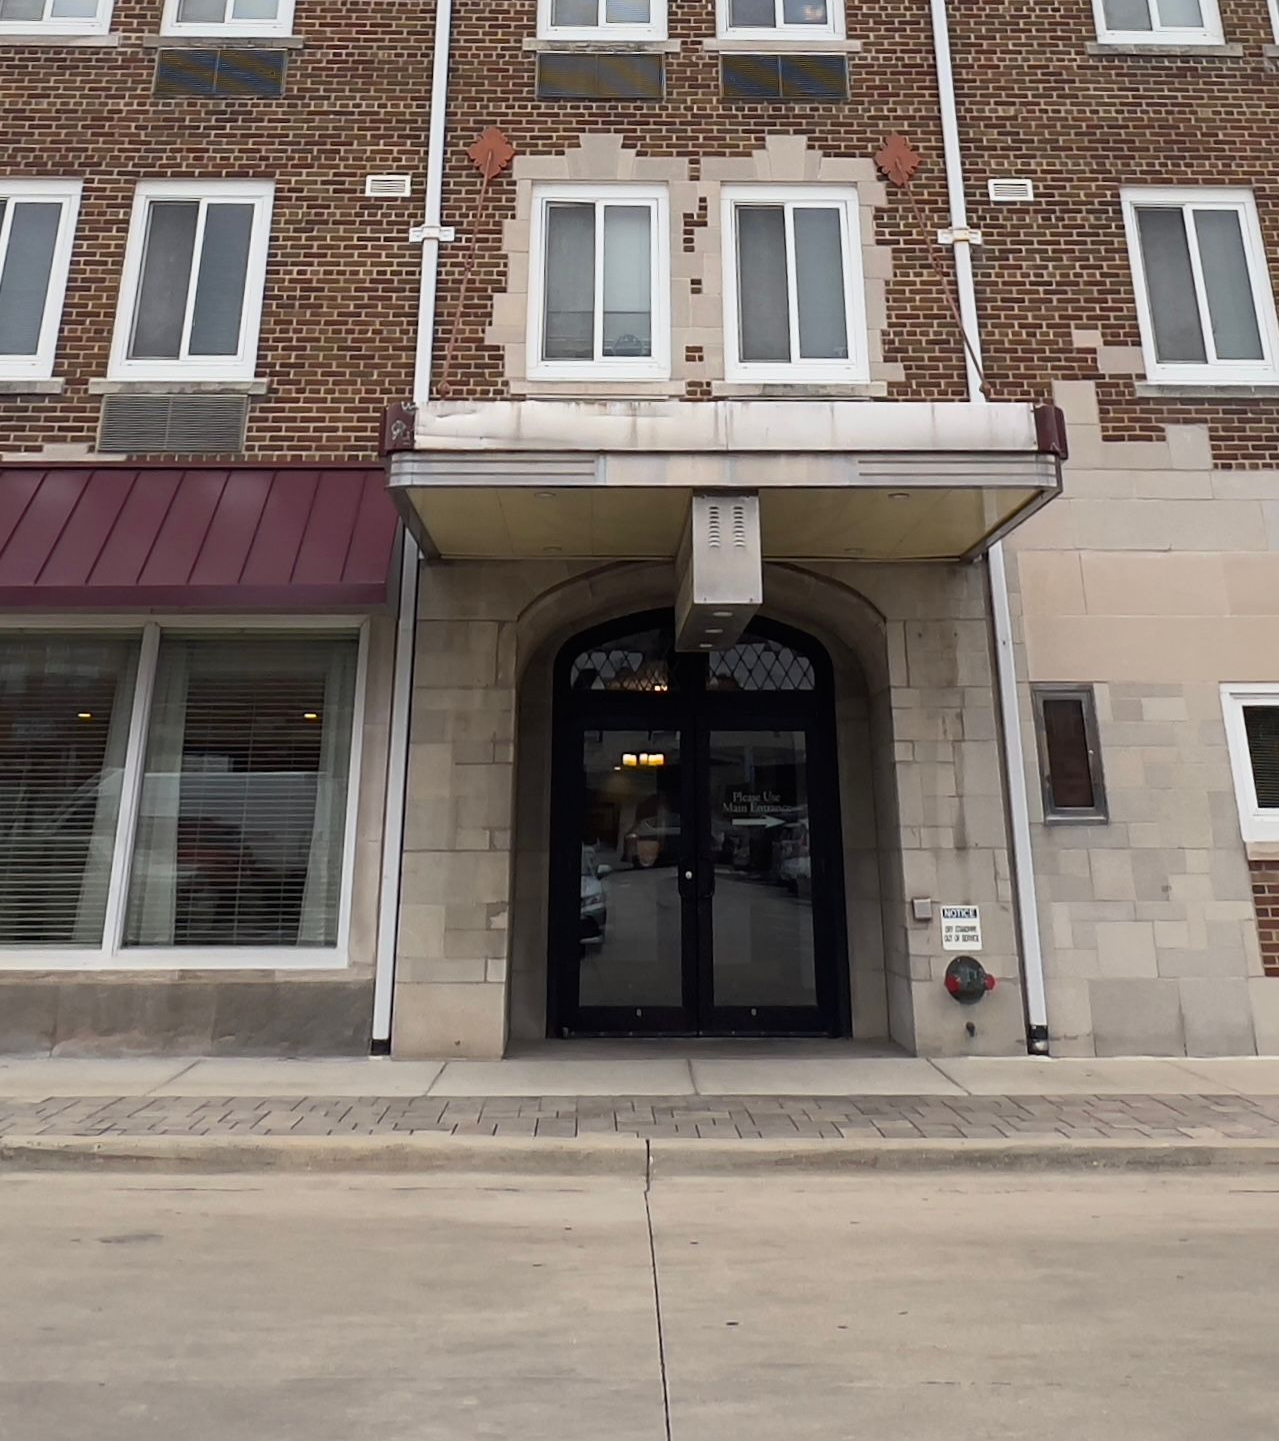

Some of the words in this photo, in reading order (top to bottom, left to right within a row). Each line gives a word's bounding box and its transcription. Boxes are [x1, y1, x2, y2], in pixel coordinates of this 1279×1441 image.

[732, 791, 760, 802] Please
[763, 791, 781, 802] Use
[722, 802, 747, 813] Main
[944, 908, 976, 918] NOTICE
